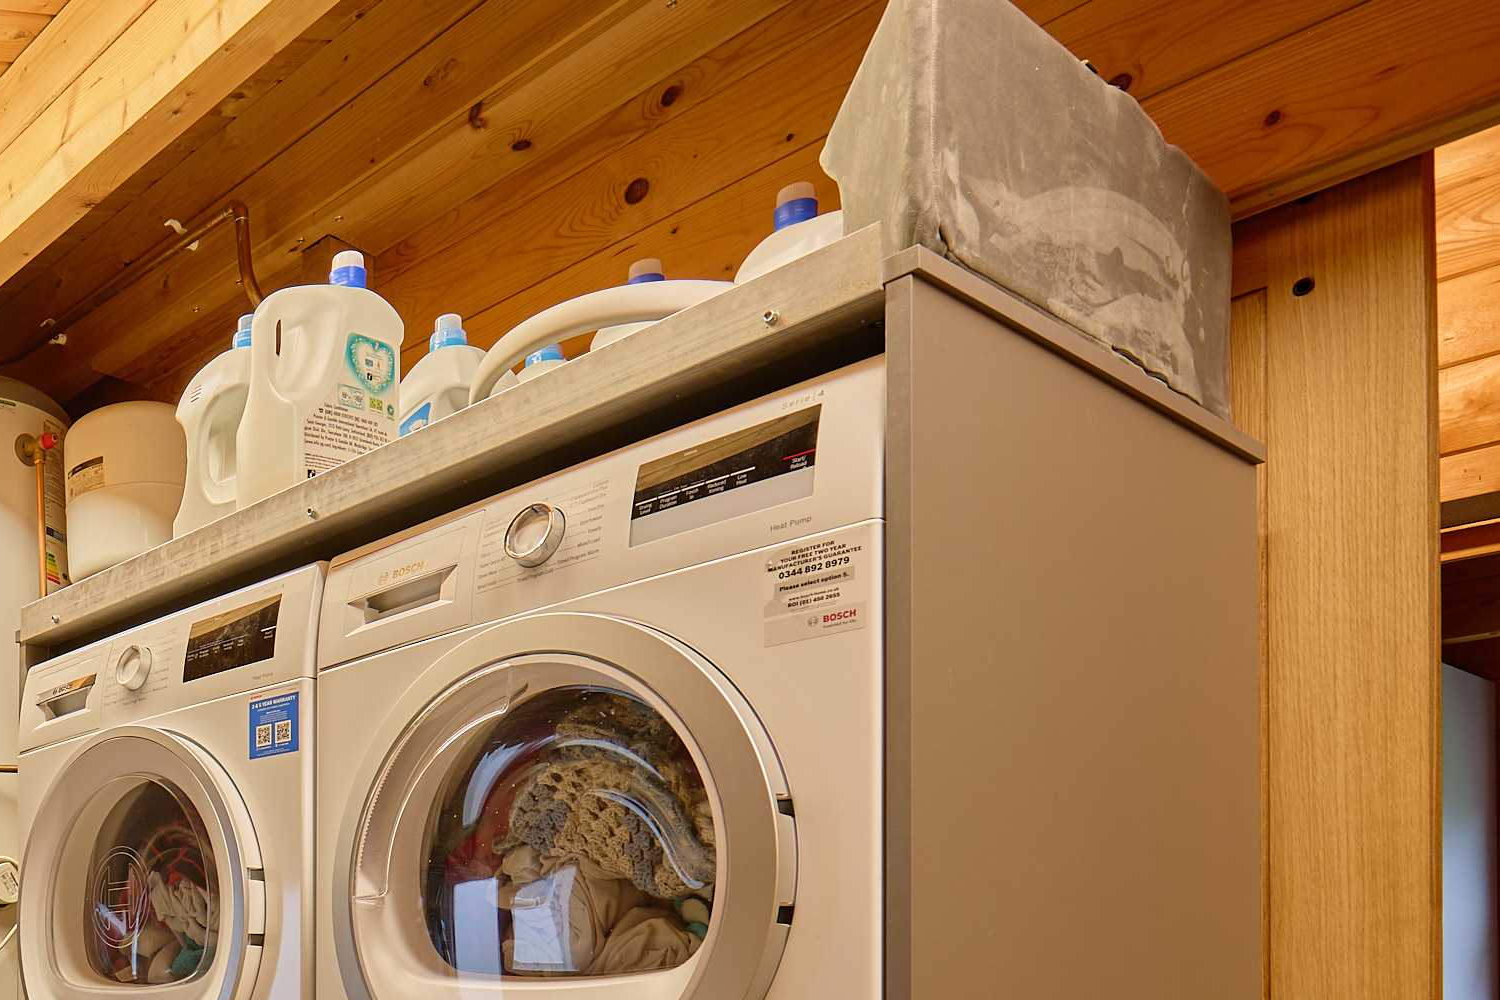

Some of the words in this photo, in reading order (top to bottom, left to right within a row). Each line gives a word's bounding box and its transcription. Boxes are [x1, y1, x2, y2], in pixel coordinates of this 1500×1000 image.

[782, 395, 811, 410] Serie
[818, 389, 825, 397] 4
[790, 460, 807, 470] Reload
[791, 455, 807, 464] Start/
[707, 479, 727, 489] Reduced
[580, 515, 602, 526] Sportswear
[770, 522, 788, 532] Heat
[789, 516, 812, 528] Pump
[588, 526, 601, 534] Towels
[577, 540, 589, 548] Mixed
[791, 542, 820, 555] REGISTER
[570, 552, 587, 562] Program
[798, 551, 813, 559] FREE
[814, 548, 829, 556] TWO
[830, 544, 846, 552] YEAR
[768, 555, 822, 572] MANUFACTURER'S
[824, 546, 862, 559] GUARANTEE
[392, 561, 424, 579] BOSCH
[779, 567, 803, 579] 0344
[804, 563, 823, 574] 892
[825, 556, 850, 568] 8979
[516, 575, 528, 583] Timed
[528, 570, 544, 580] Program
[779, 584, 799, 592] Please
[801, 579, 820, 587] select
[821, 574, 841, 583] option
[800, 598, 811, 606] (01)
[823, 609, 857, 623] BOSCH
[273, 695, 296, 704] WARRANTY
